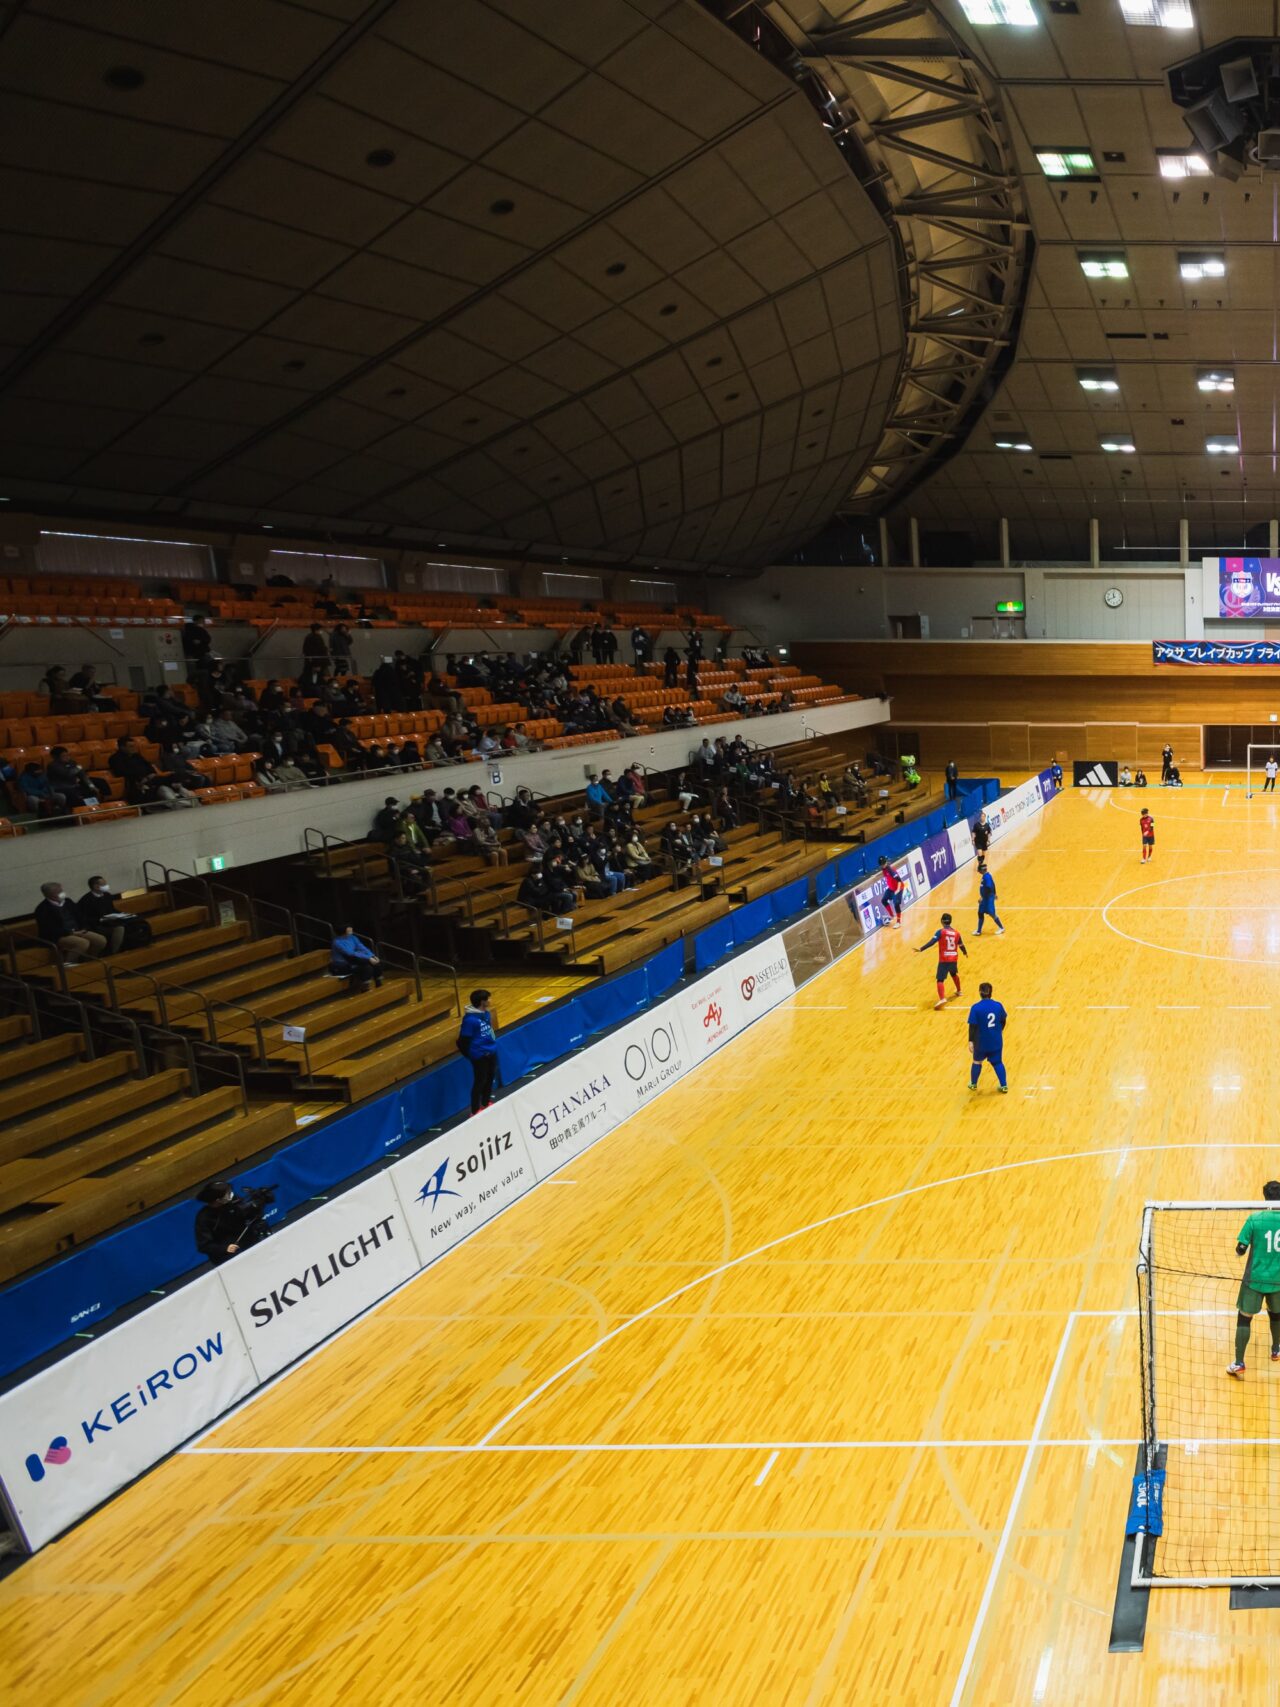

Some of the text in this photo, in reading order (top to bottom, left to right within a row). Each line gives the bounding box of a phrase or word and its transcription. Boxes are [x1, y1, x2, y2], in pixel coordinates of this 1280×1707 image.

[1155, 647, 1184, 658] アクサ
[1187, 647, 1254, 658] ブレイブカップ
[930, 846, 946, 872] アクサ
[875, 905, 880, 919] 3
[987, 1013, 995, 1028] 2
[549, 1074, 612, 1123] TANAKA
[456, 1131, 513, 1182] sojitz
[430, 1166, 525, 1239] New way, New value
[250, 1214, 394, 1328] SKYLIGHT
[81, 1332, 223, 1443] KEiROW
